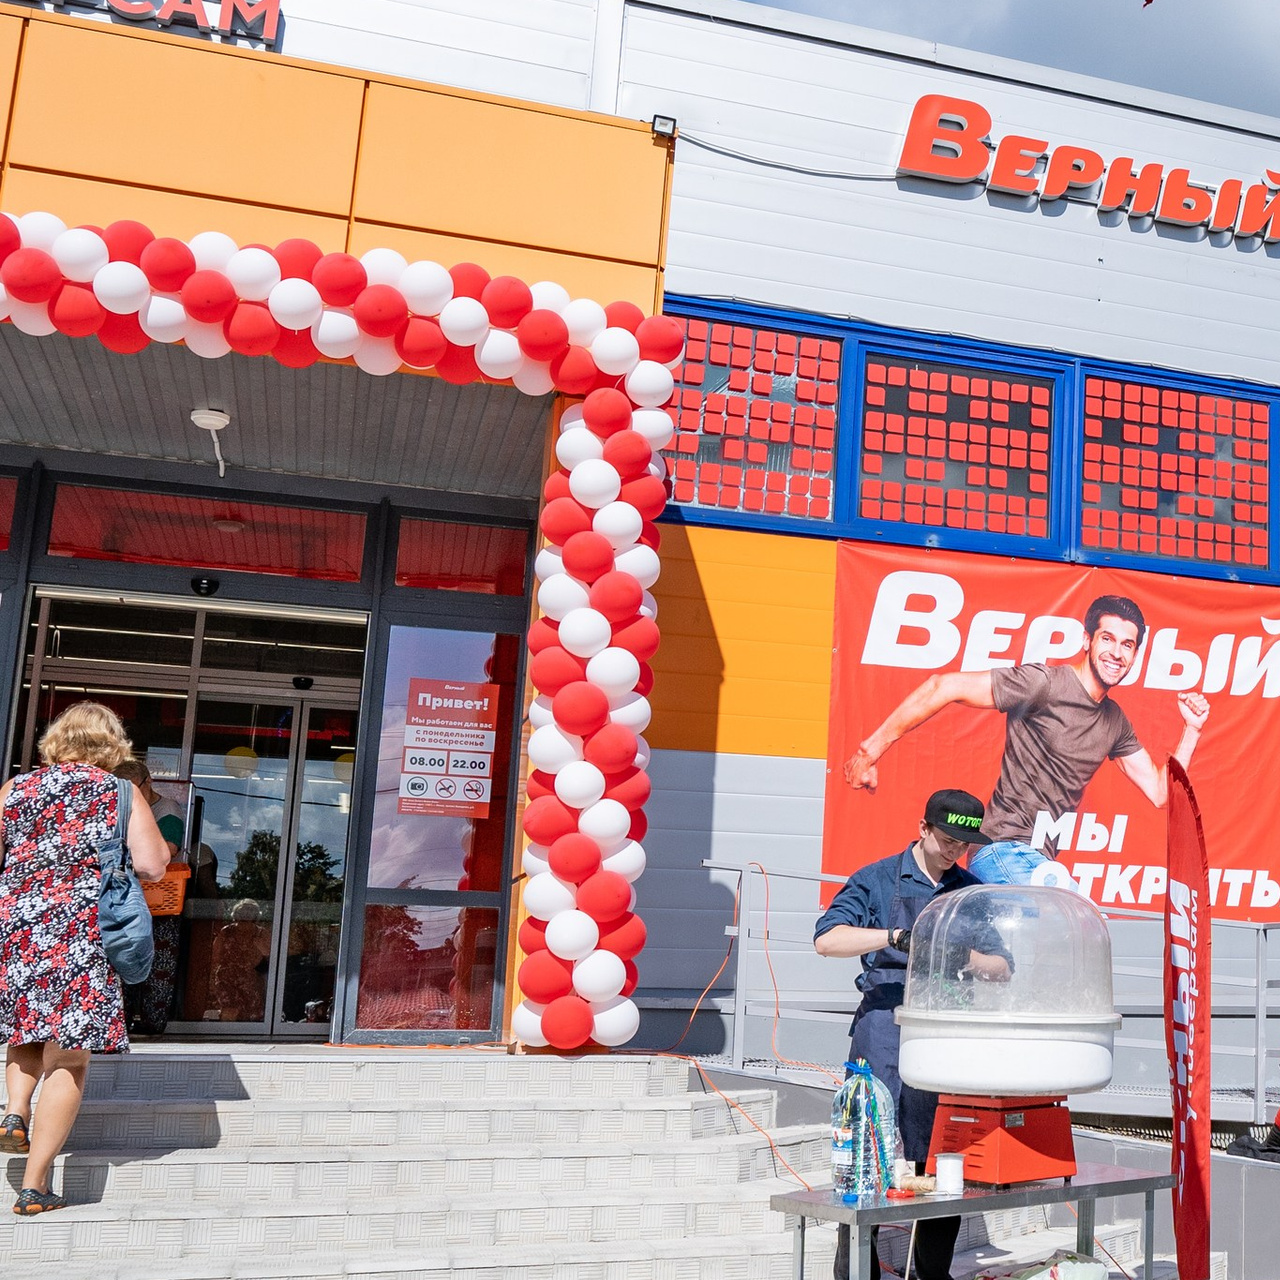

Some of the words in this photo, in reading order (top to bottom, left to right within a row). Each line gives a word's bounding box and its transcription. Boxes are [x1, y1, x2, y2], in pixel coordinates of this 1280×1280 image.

[418, 692, 489, 711] Привет!
[411, 716, 425, 724] Мы
[426, 718, 463, 727] работаем
[422, 730, 486, 740] понедельника
[428, 737, 485, 747] воскресенье
[409, 756, 445, 768] 08.00
[452, 759, 486, 770] 22.00
[1030, 810, 1128, 853] МЫ
